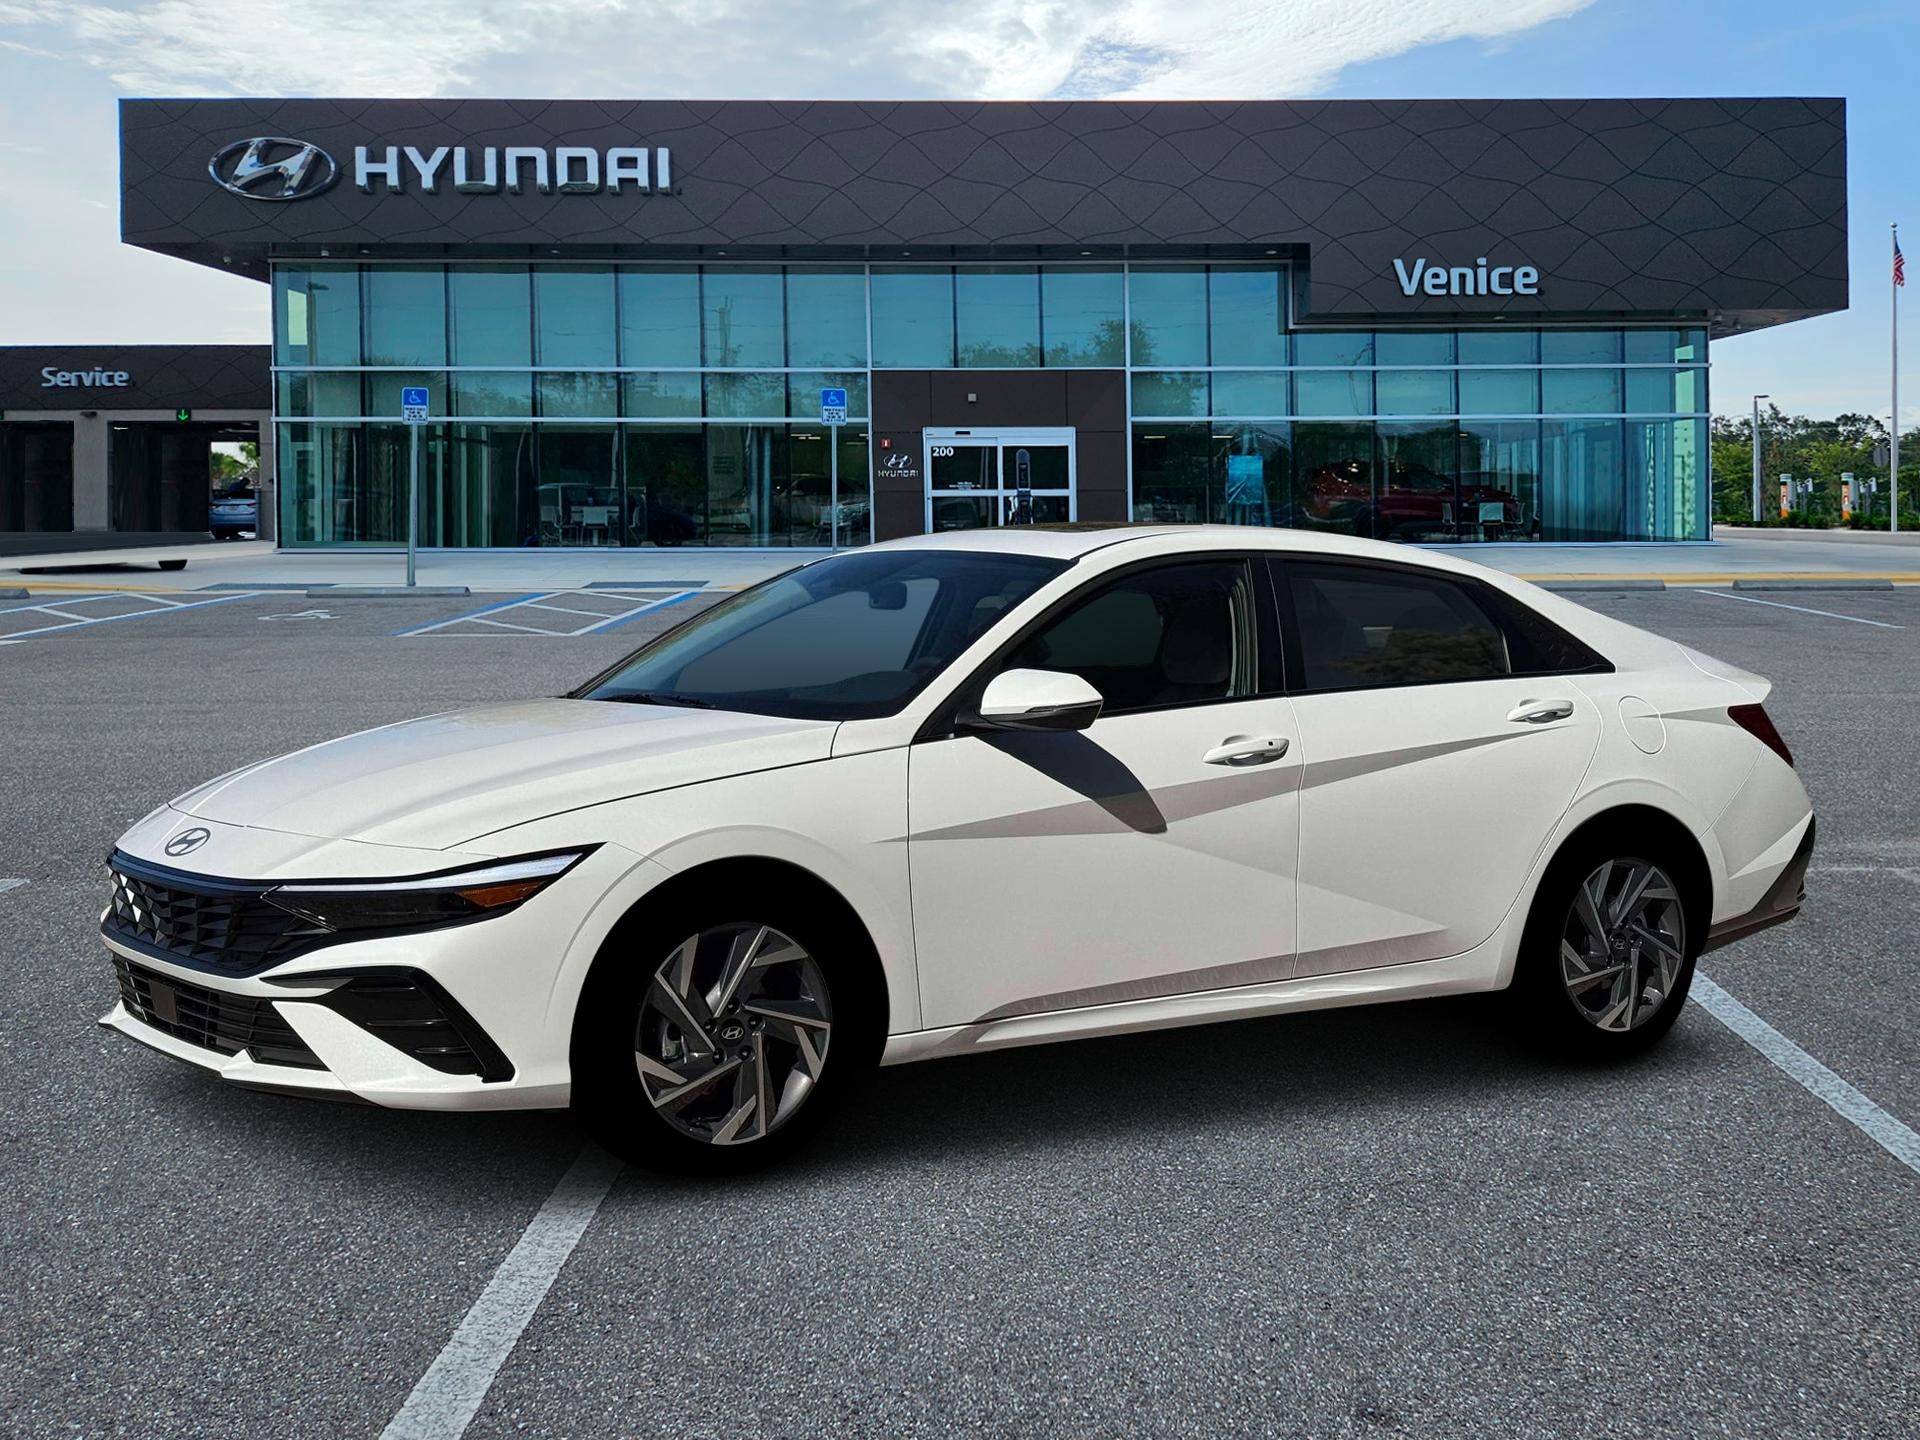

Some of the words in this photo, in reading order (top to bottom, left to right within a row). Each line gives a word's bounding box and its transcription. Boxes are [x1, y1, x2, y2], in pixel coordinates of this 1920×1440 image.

[354, 145, 672, 195] HYUNDAI
[1392, 256, 1539, 296] Venice
[41, 366, 130, 388] Service
[932, 446, 954, 457] 200
[877, 469, 919, 478] HYUNDAI
